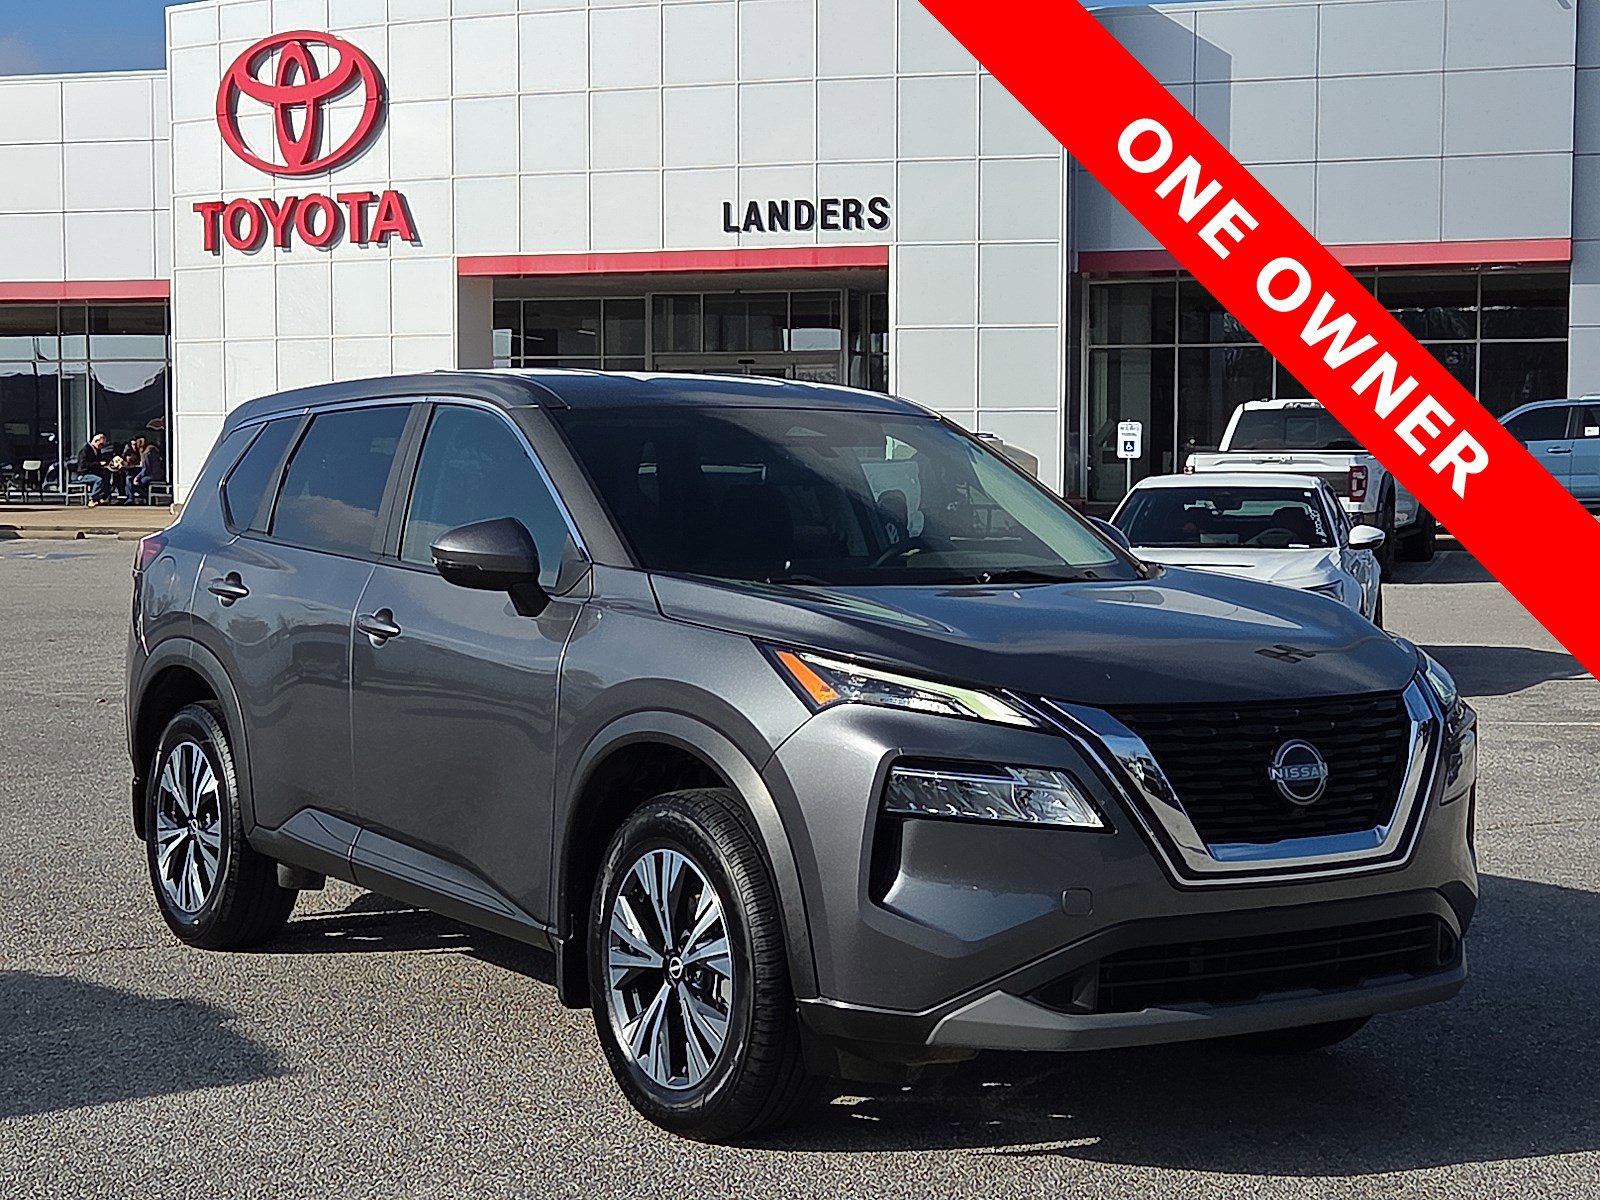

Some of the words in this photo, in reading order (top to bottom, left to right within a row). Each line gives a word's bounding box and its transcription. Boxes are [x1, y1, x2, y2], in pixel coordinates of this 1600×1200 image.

[193, 190, 416, 251] TOYOTA
[723, 197, 891, 233] LANDERS
[1270, 764, 1328, 780] NISSAN
